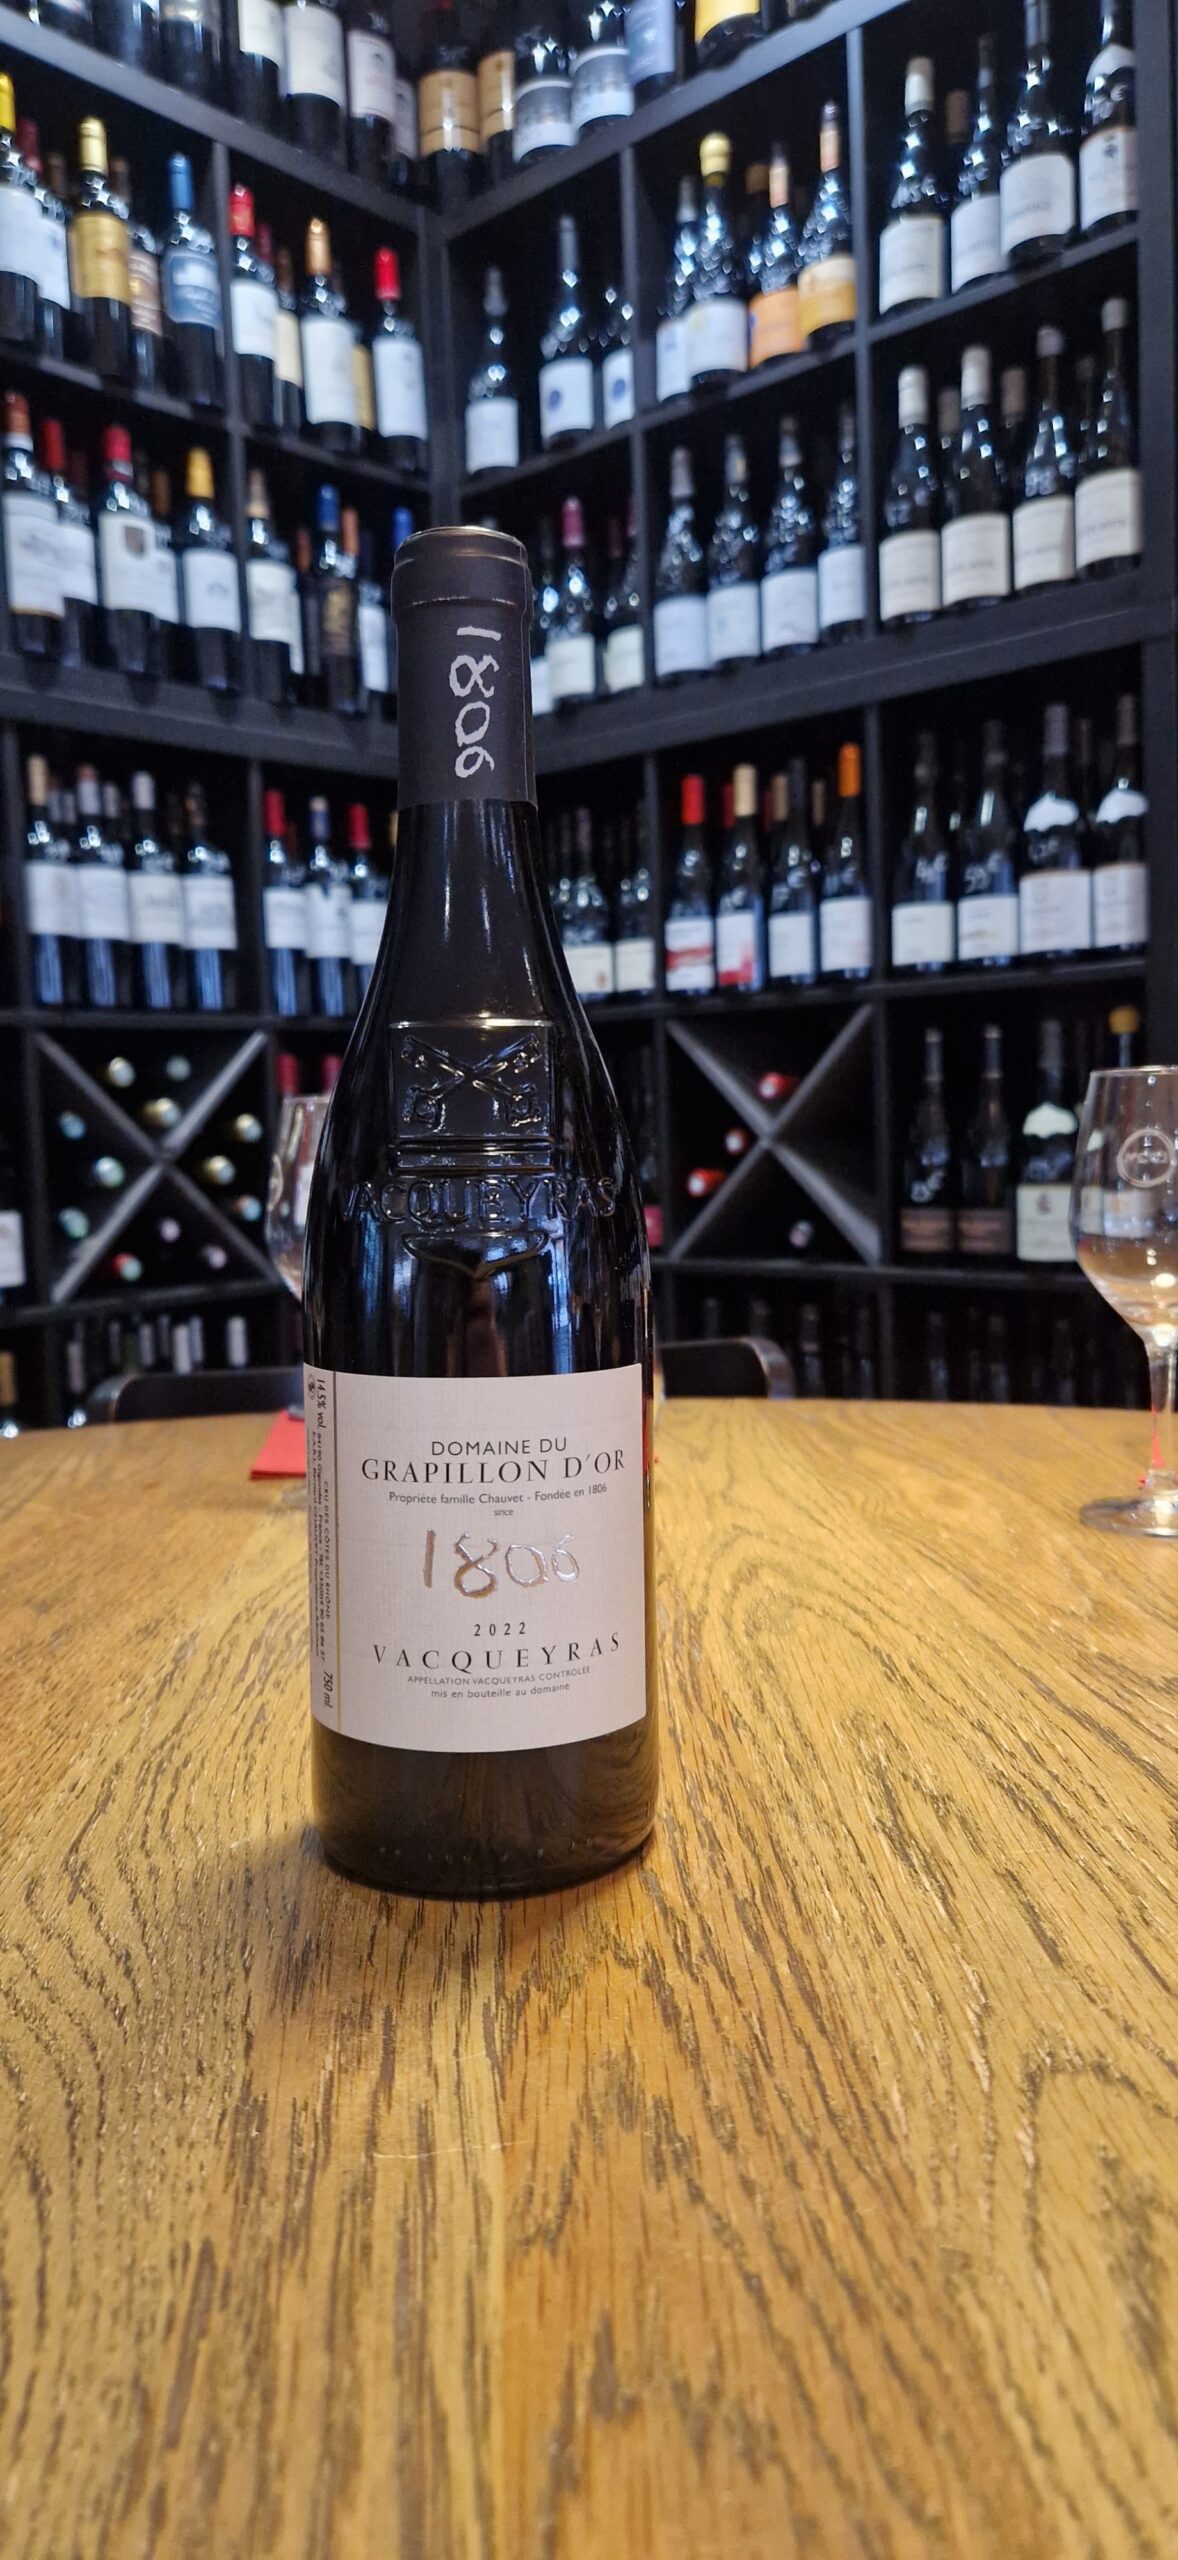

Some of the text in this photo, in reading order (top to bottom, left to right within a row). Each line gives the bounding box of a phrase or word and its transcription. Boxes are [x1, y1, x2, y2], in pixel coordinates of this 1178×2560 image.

[449, 625, 501, 779] 1806
[343, 1176, 616, 1228] VACQUEYRAS
[431, 1437, 567, 1456] DOMAINE DU
[361, 1449, 625, 1484] GRAPILLON D'OR
[440, 1493, 475, 1504] famille
[478, 1493, 524, 1504] Chauvet
[534, 1489, 571, 1502] Fondée
[573, 1488, 585, 1497] en
[588, 1482, 608, 1495] 1806
[493, 1508, 514, 1517] since
[325, 1564, 330, 1579] DU
[422, 1528, 580, 1599] 1806
[473, 1621, 527, 1638] 2022
[373, 1632, 620, 1675] VACQUEYRAS
[323, 1671, 333, 1693] 750
[407, 1675, 470, 1686] APPELLATION
[472, 1674, 536, 1686] VACQUEYRAS
[431, 1682, 571, 1699] mis en bouteille au domaine
